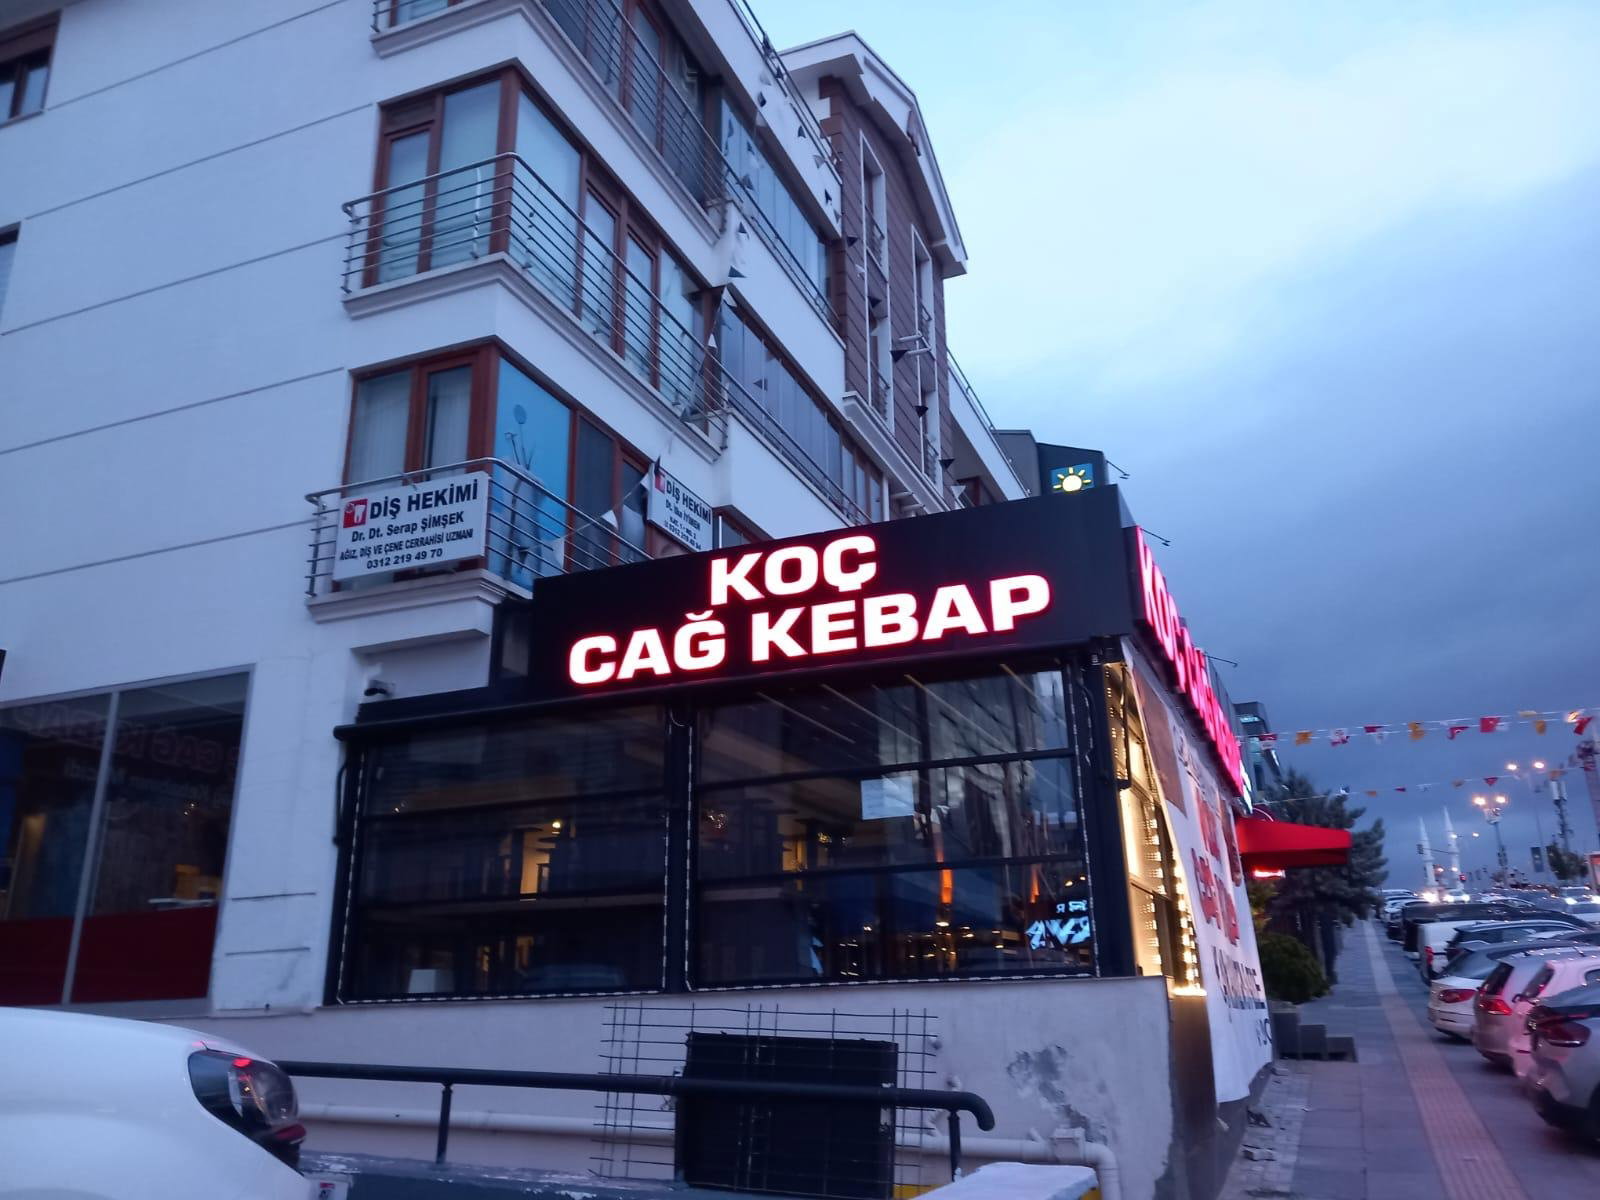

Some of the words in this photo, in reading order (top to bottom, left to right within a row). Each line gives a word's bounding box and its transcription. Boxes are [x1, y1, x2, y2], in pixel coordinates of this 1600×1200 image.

[370, 496, 400, 519] DİŞ
[407, 479, 478, 512] HEKİMİ
[682, 493, 711, 525] HEKİMİ
[352, 530, 365, 542] Dr.
[369, 527, 383, 539] Dt.
[387, 522, 418, 536] Serap
[421, 510, 465, 532] ŞİMŞEK
[366, 557, 391, 569] 0312
[393, 553, 412, 564] 219
[414, 550, 427, 560] 49
[430, 547, 443, 558] 70
[374, 544, 383, 554] VE
[709, 535, 878, 607] KOÇ
[568, 610, 726, 685] CAĞ
[751, 573, 1051, 663] KEBAP
